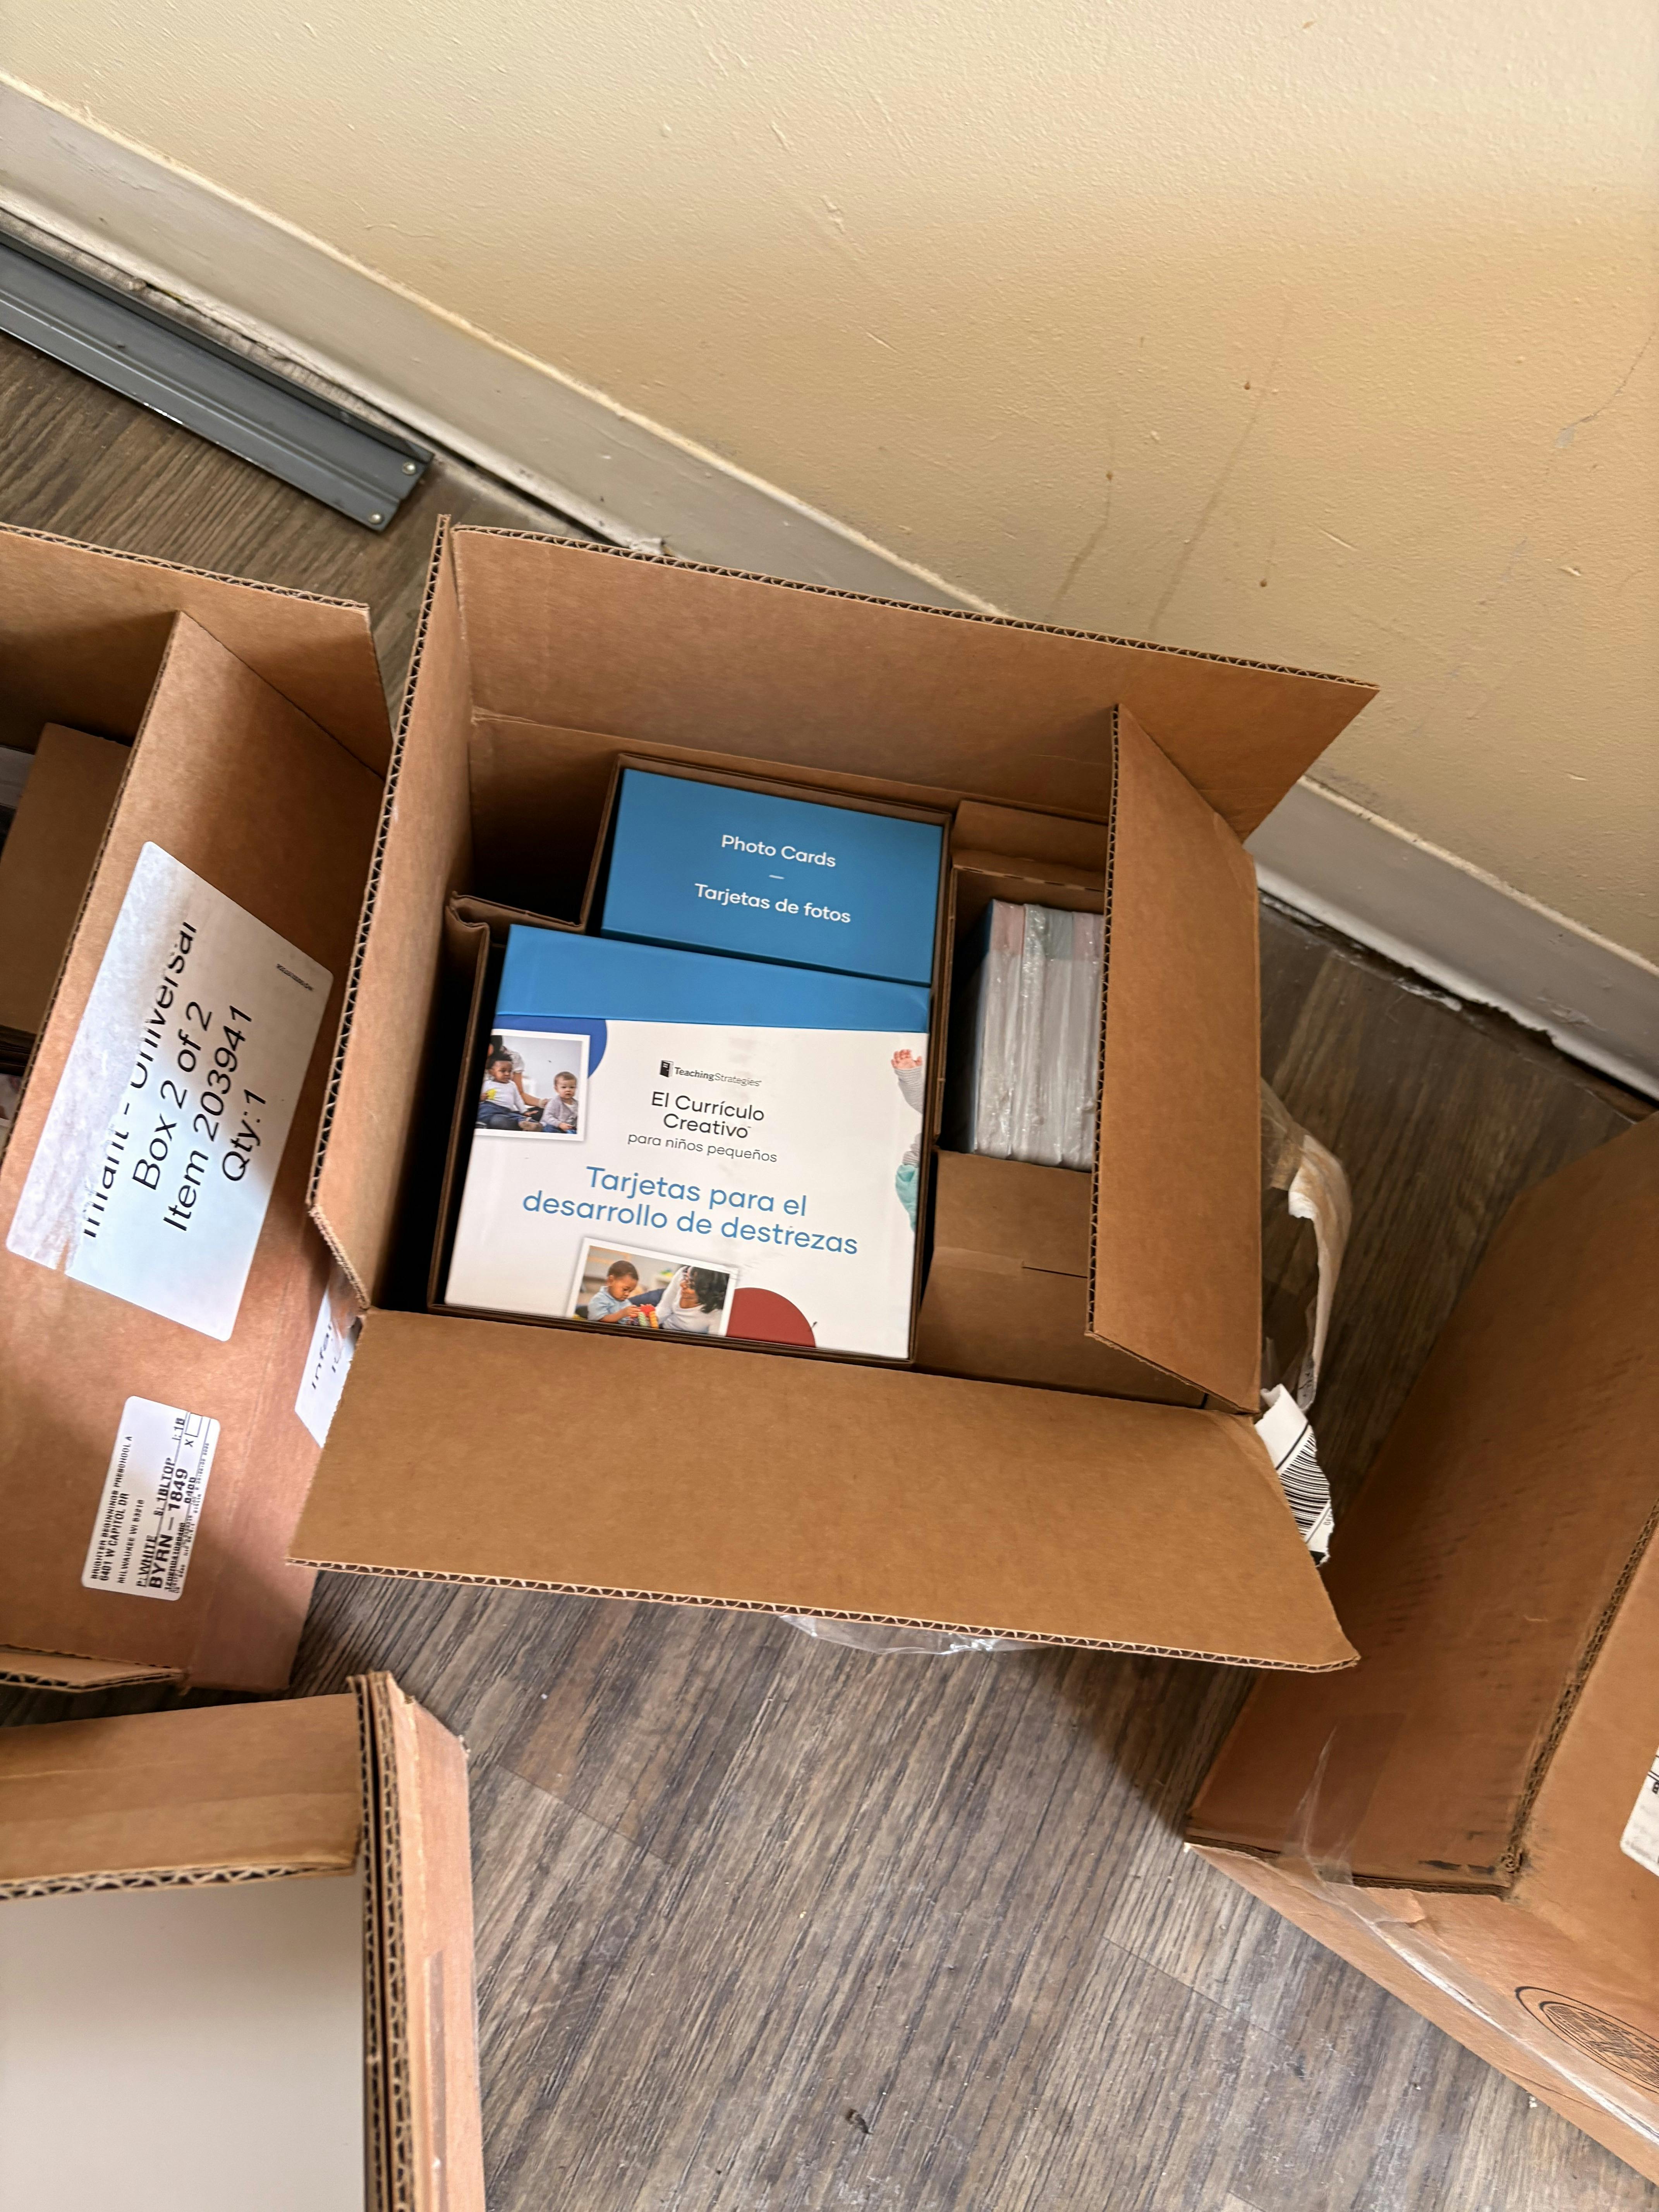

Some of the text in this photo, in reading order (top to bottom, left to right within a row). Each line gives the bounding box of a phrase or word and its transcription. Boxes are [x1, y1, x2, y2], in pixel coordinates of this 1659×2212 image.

[722, 835, 835, 867] Photo Cards
[695, 884, 850, 922] Tarjetas de fotos
[132, 1002, 212, 1190] Box 2 of 2
[163, 1005, 254, 1231] Item 203941
[652, 1092, 764, 1120] El Currículo
[222, 1085, 273, 1181] Qty:1
[664, 1114, 749, 1138] Creativo
[628, 1135, 777, 1162] para niños pequeños
[586, 1166, 806, 1216] Tarjetas para el
[523, 1190, 857, 1254] desarrollo de destrezas
[107, 1509, 126, 1546] CAPITOL
[148, 1534, 173, 1589] BYRN
[167, 1468, 188, 1511] 1849
